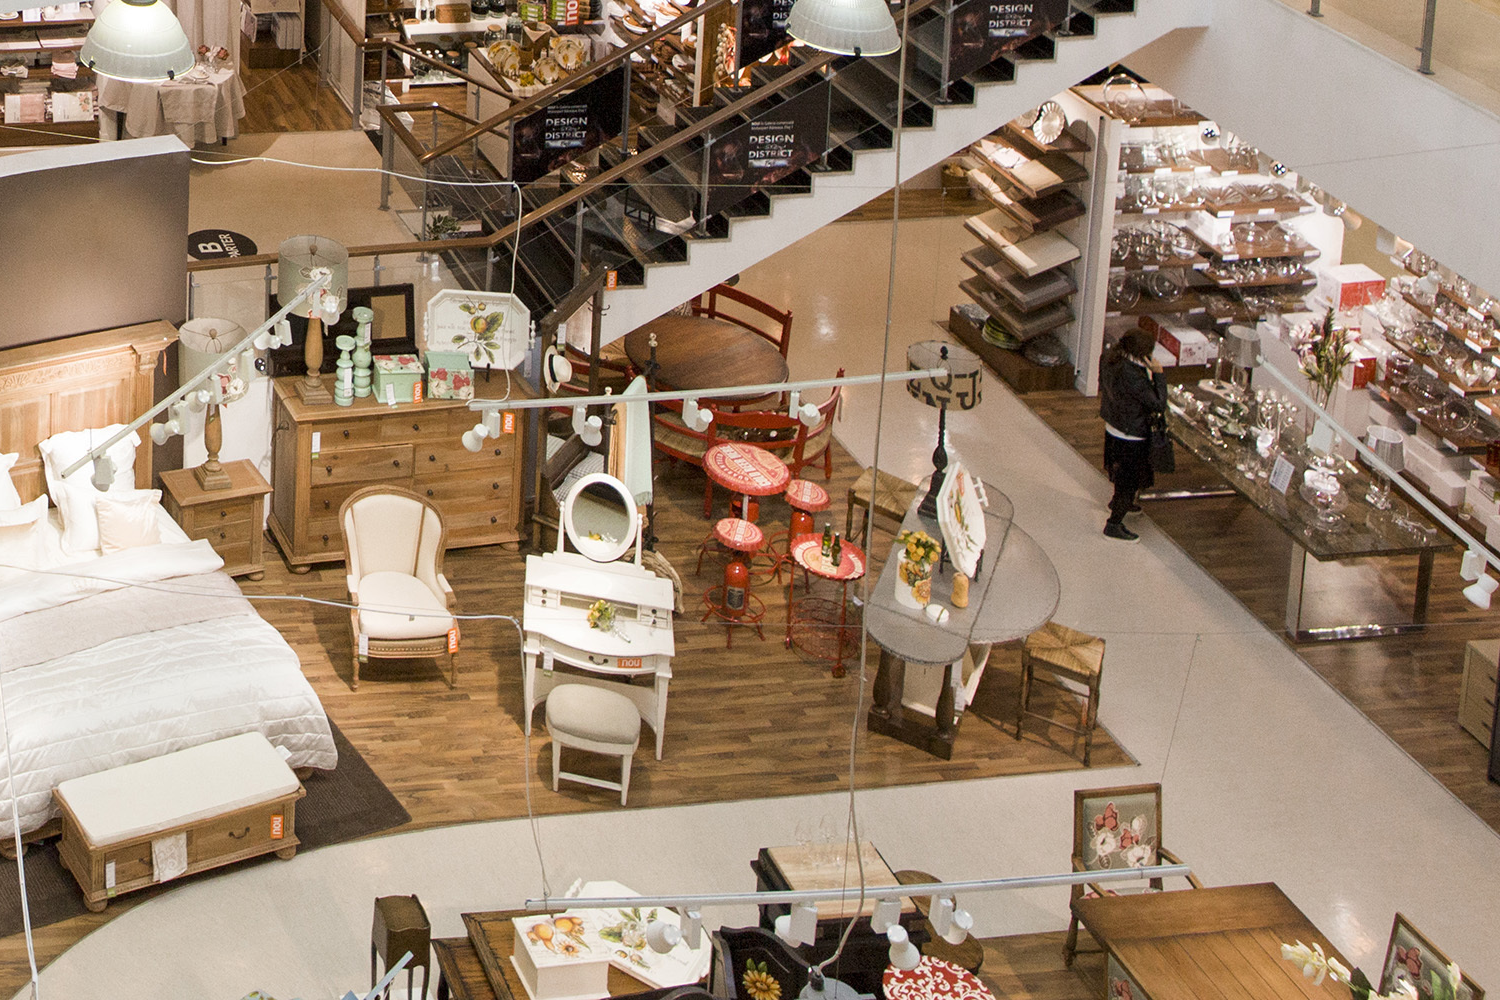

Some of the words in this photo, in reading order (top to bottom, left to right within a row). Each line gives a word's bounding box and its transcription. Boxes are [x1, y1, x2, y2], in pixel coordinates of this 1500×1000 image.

[989, 3, 1034, 13] DESIGN
[989, 18, 1032, 28] DISTRICT
[545, 117, 588, 126] DESIGN
[545, 130, 587, 139] DISTRICT
[749, 134, 795, 144] DESIGN
[748, 149, 793, 158] DISTRICT
[198, 241, 223, 253] B
[608, 272, 616, 288] nou
[504, 414, 513, 431] nou
[449, 630, 457, 649] nou
[621, 659, 641, 667] nou
[272, 816, 281, 835] nou
